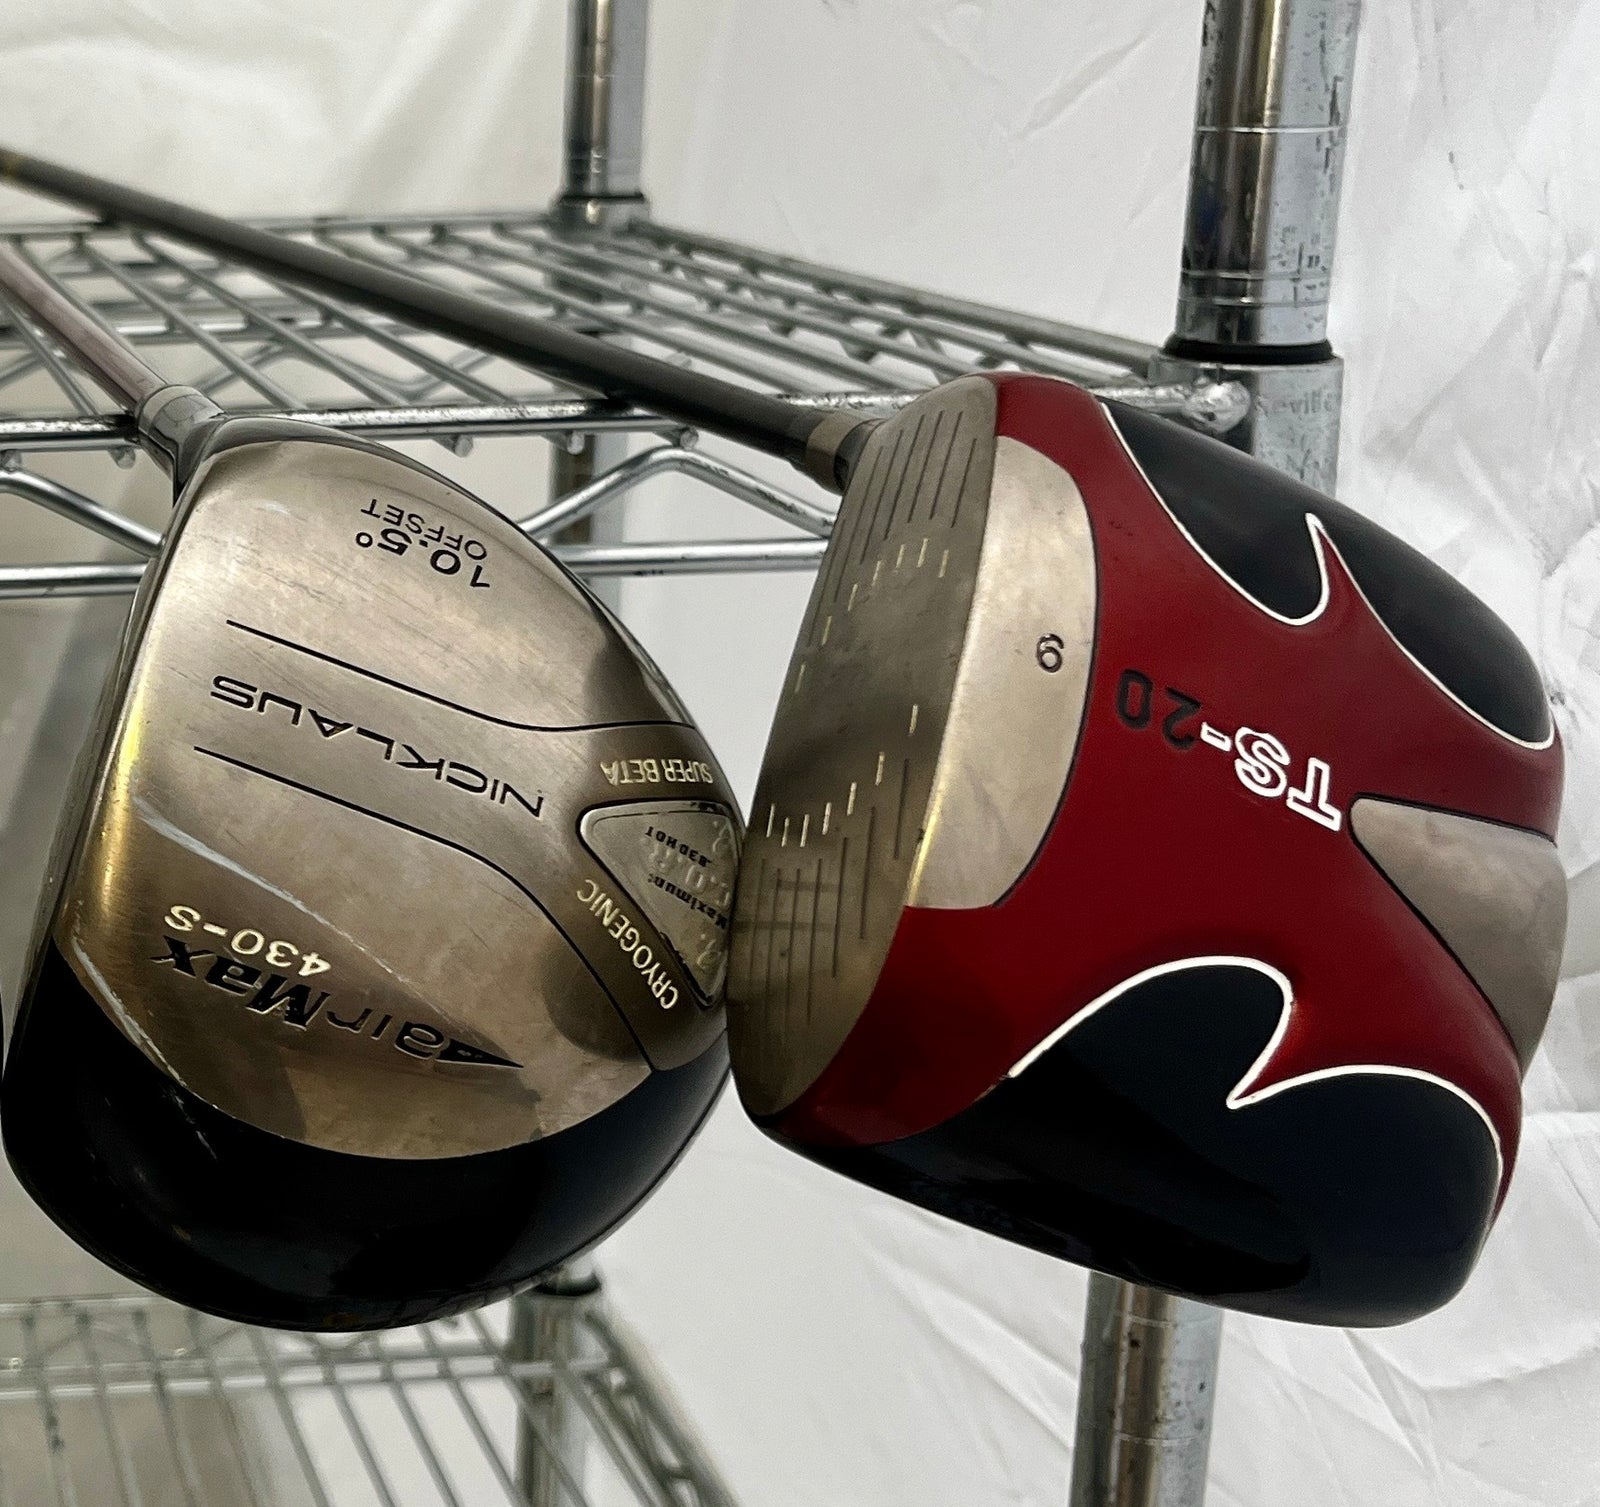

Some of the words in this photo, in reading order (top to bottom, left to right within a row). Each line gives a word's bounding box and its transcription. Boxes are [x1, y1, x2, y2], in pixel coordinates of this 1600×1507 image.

[355, 528, 491, 588] 10.5°
[360, 498, 488, 561] OFFSET
[210, 675, 544, 818] NICKLAUS
[600, 758, 661, 786] BETA
[664, 758, 714, 784] SUPER
[1115, 667, 1342, 832] TS-20
[163, 905, 331, 977] 430-S
[576, 879, 679, 1010] CRYOGENIC
